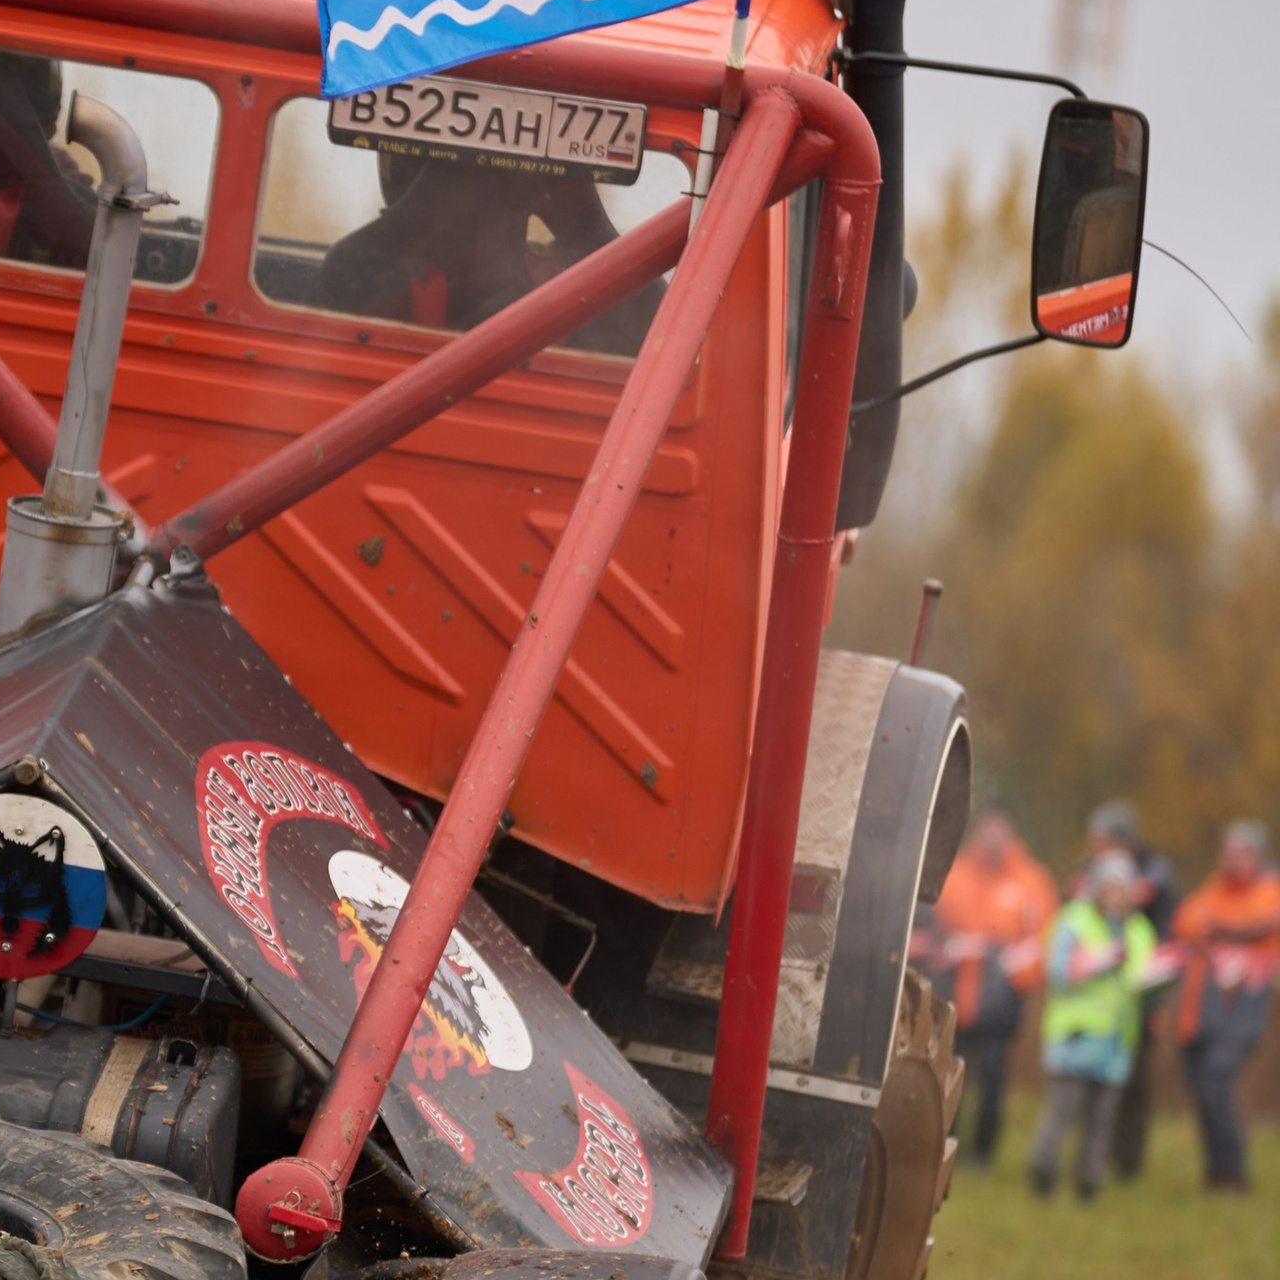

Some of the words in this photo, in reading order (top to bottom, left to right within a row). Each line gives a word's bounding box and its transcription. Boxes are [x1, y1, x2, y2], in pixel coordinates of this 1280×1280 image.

[557, 103, 630, 145] 777
[568, 140, 606, 158] RUS
[226, 750, 376, 839] ВОЛКИ
[539, 1092, 648, 1242] МОСКВА
